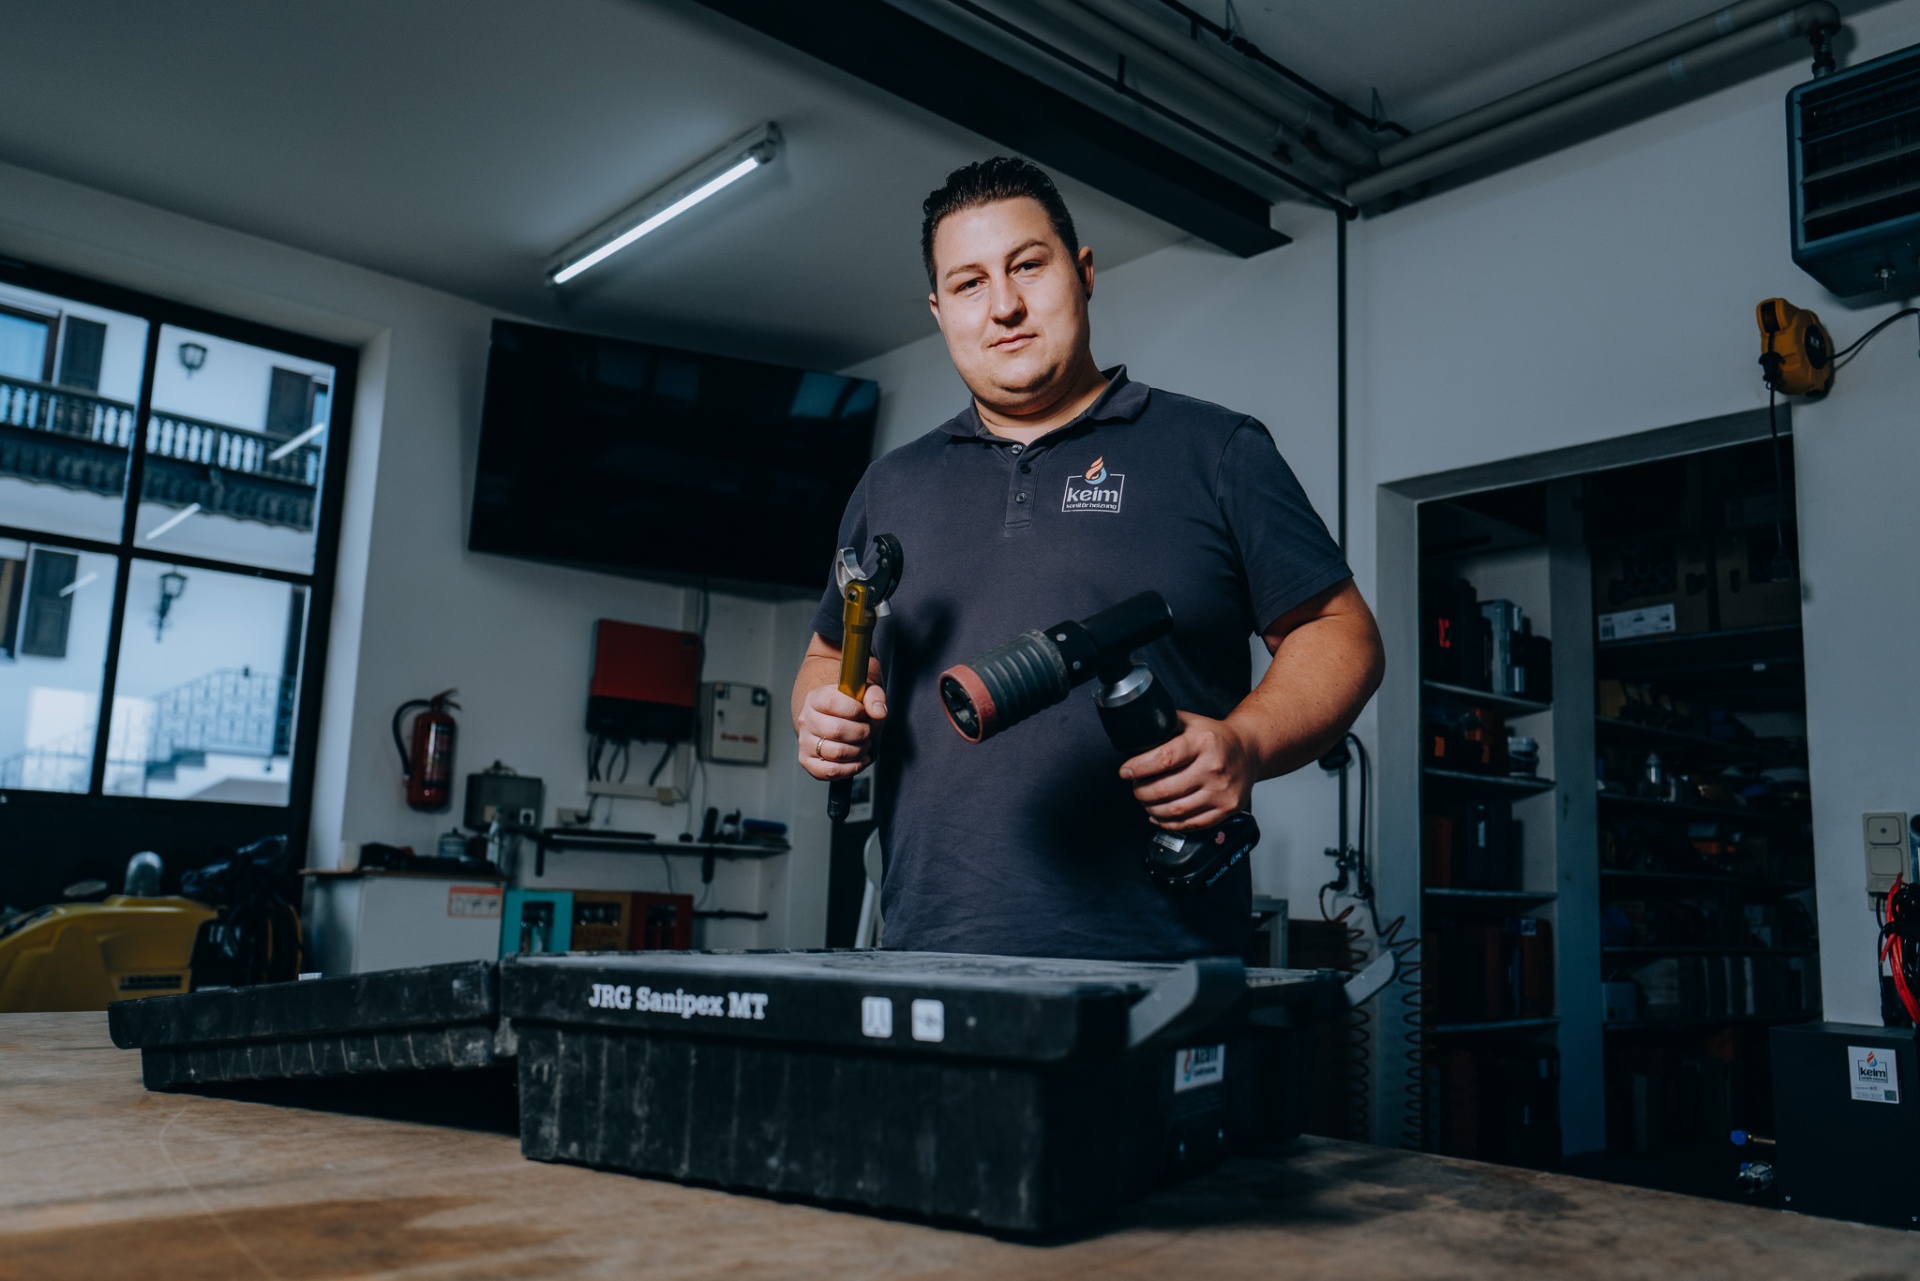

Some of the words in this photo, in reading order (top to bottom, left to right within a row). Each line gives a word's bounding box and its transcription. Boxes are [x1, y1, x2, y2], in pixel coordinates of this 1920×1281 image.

[1067, 487, 1118, 502] keim
[588, 983, 632, 1010] JRG
[635, 986, 725, 1019] Sanipex
[727, 991, 769, 1020] MT
[1860, 1067, 1886, 1078] keim
